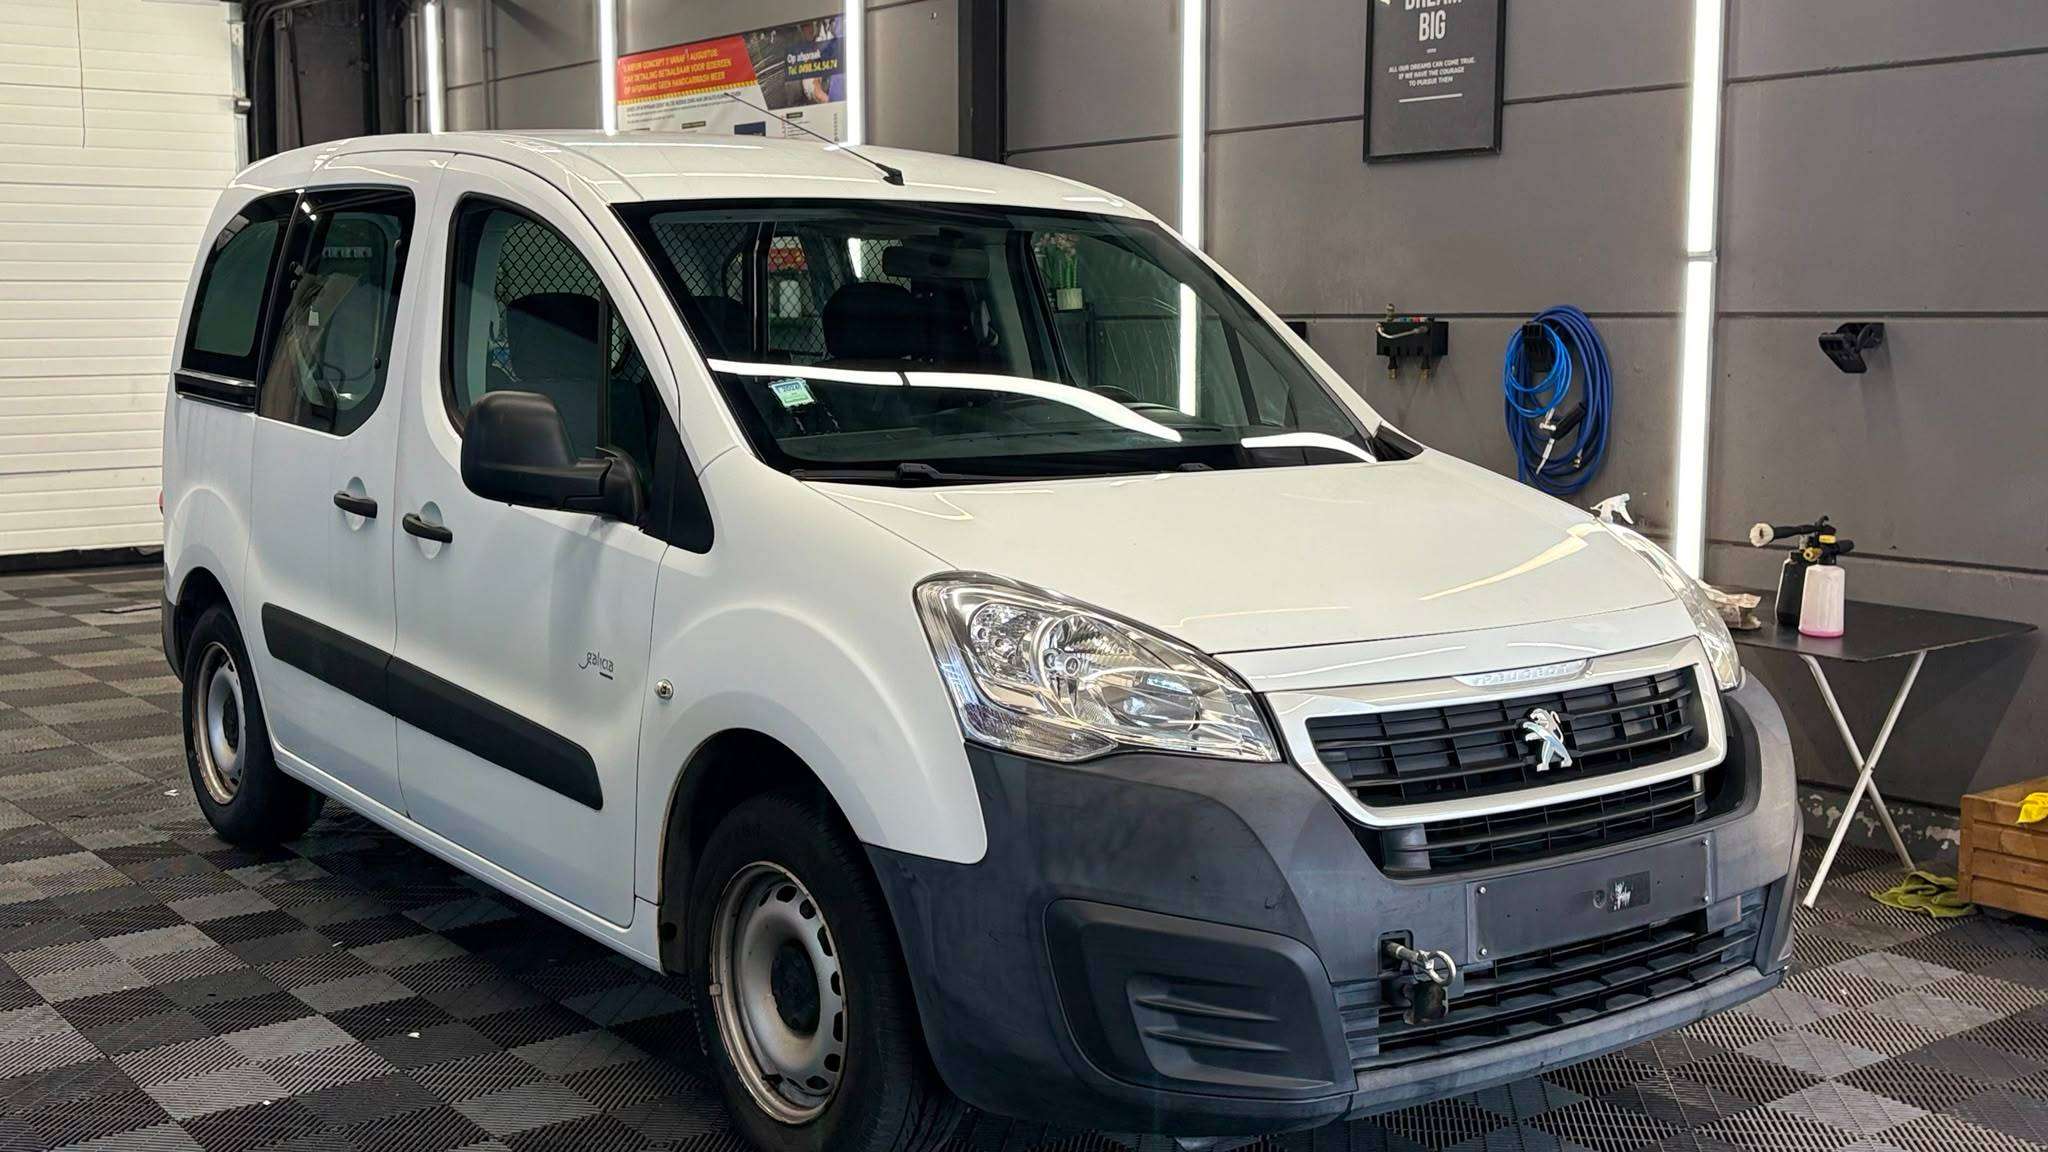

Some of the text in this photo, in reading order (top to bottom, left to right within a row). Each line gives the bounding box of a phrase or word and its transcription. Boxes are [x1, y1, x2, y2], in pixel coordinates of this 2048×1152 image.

[1418, 9, 1447, 41] BIG
[1398, 64, 1409, 72] OUR
[1410, 62, 1432, 70] DREAMS
[1432, 60, 1443, 68] CAN
[1444, 58, 1459, 67] COME
[1413, 70, 1428, 78] HAVE
[1439, 66, 1465, 75] COURAGE
[1408, 79, 1416, 87] TO
